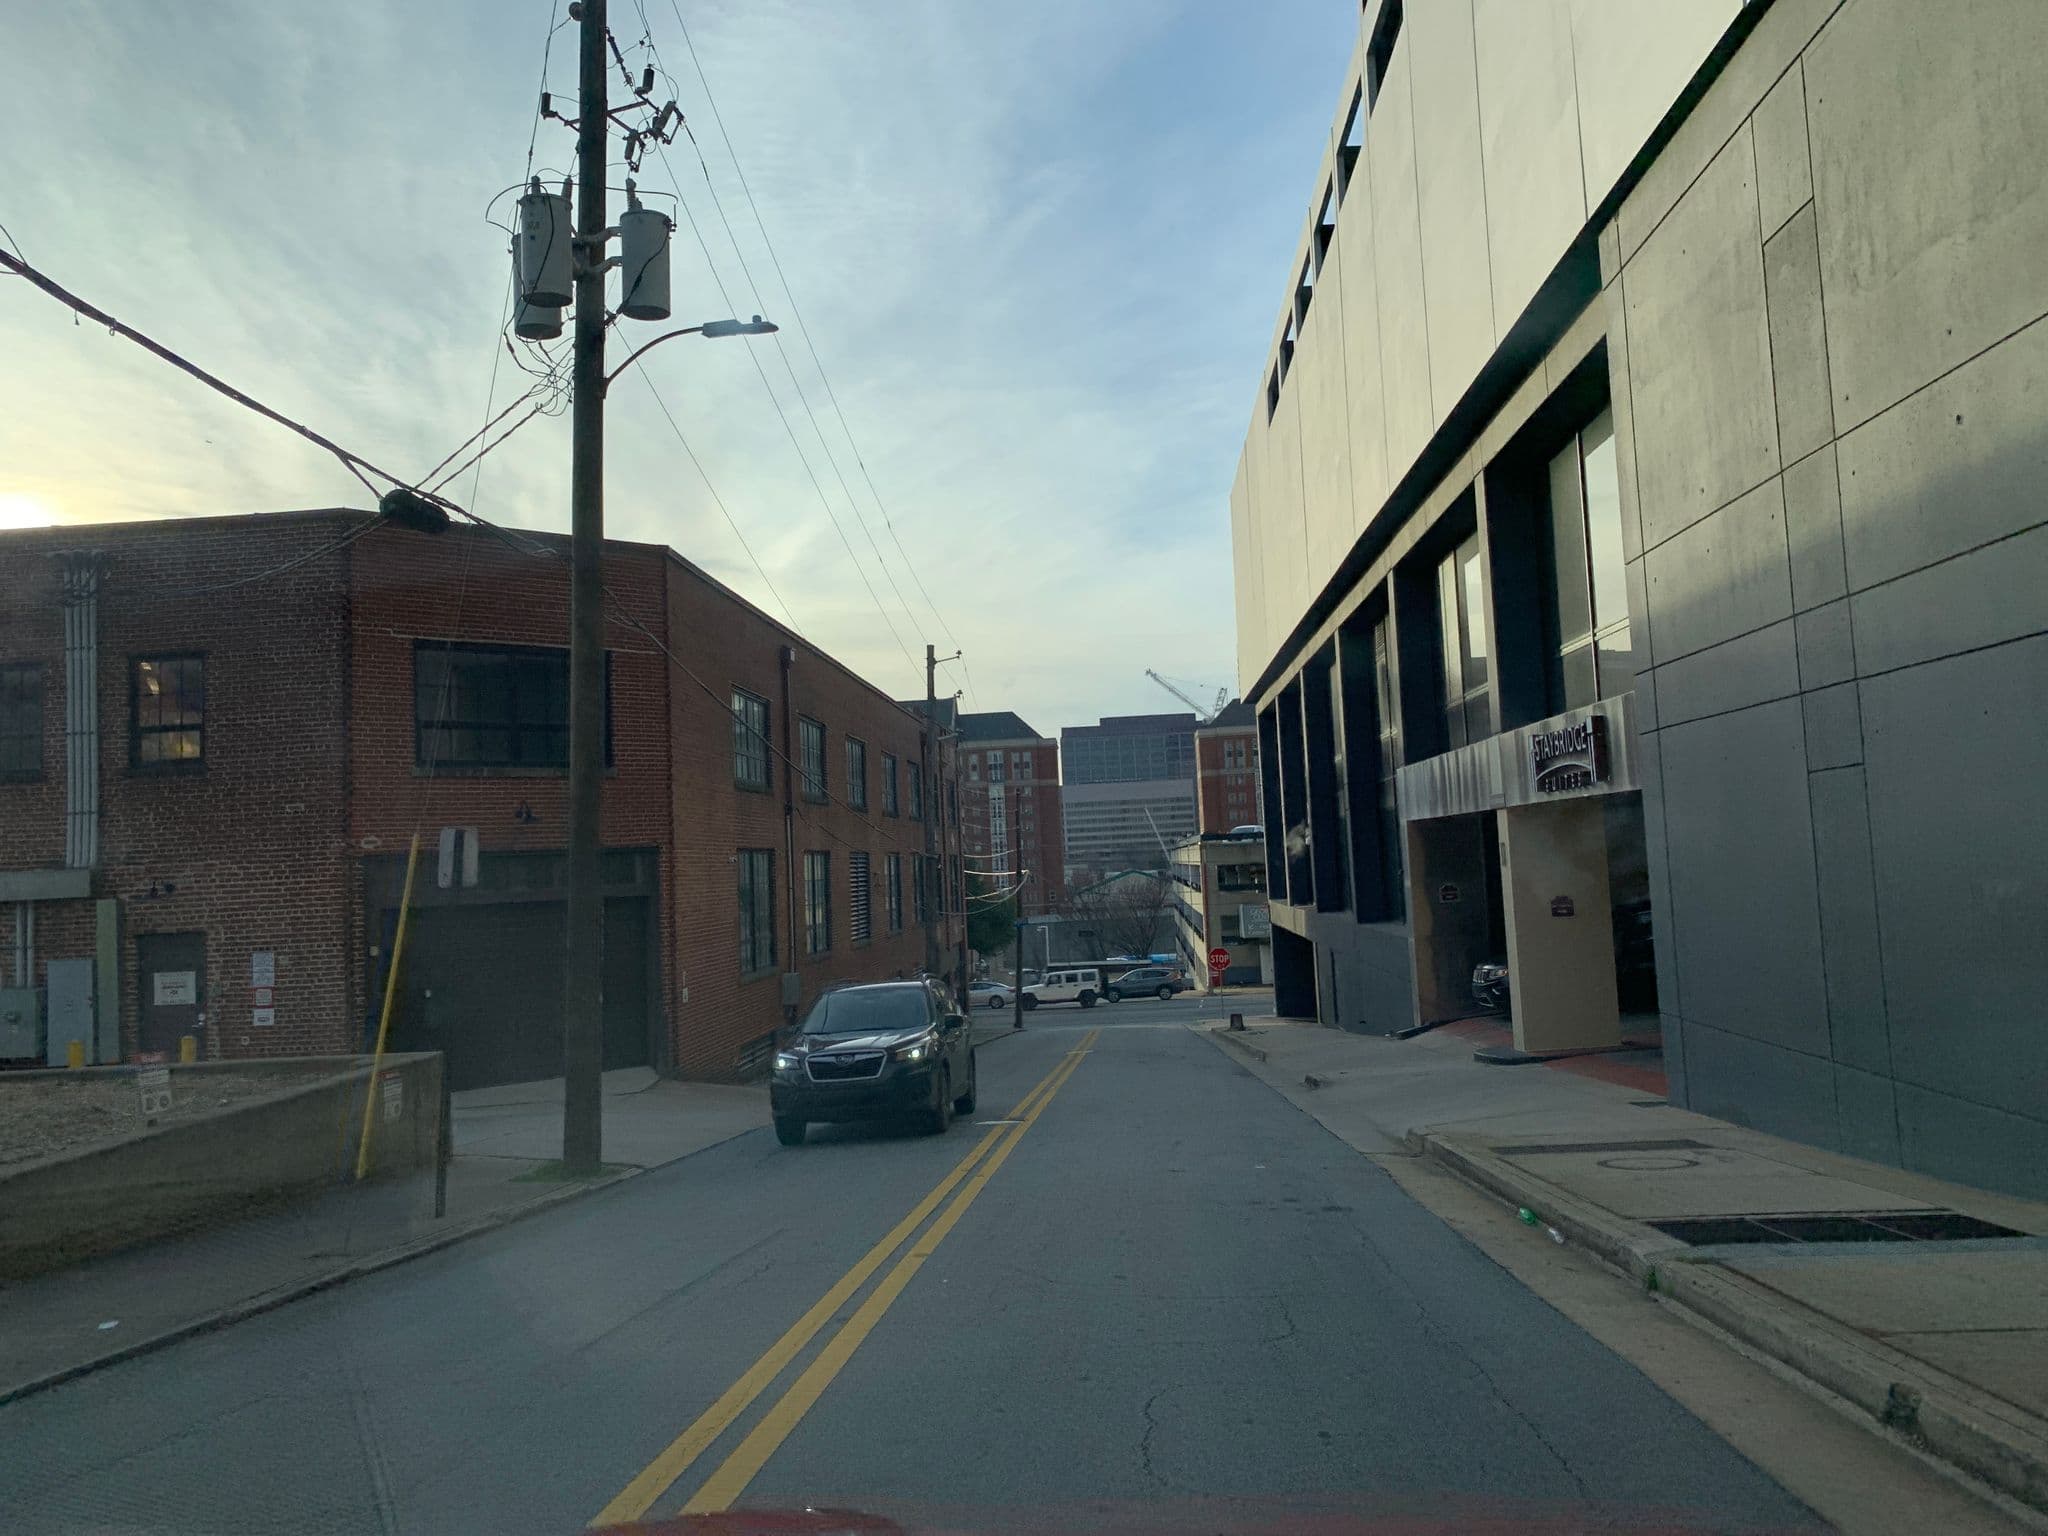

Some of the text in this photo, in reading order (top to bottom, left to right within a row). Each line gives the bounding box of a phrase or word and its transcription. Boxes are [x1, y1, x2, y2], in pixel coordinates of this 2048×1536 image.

[1535, 723, 1587, 761] STAYBRIDGE
[1545, 771, 1582, 793] SUITES
[1210, 954, 1229, 964] STOP
